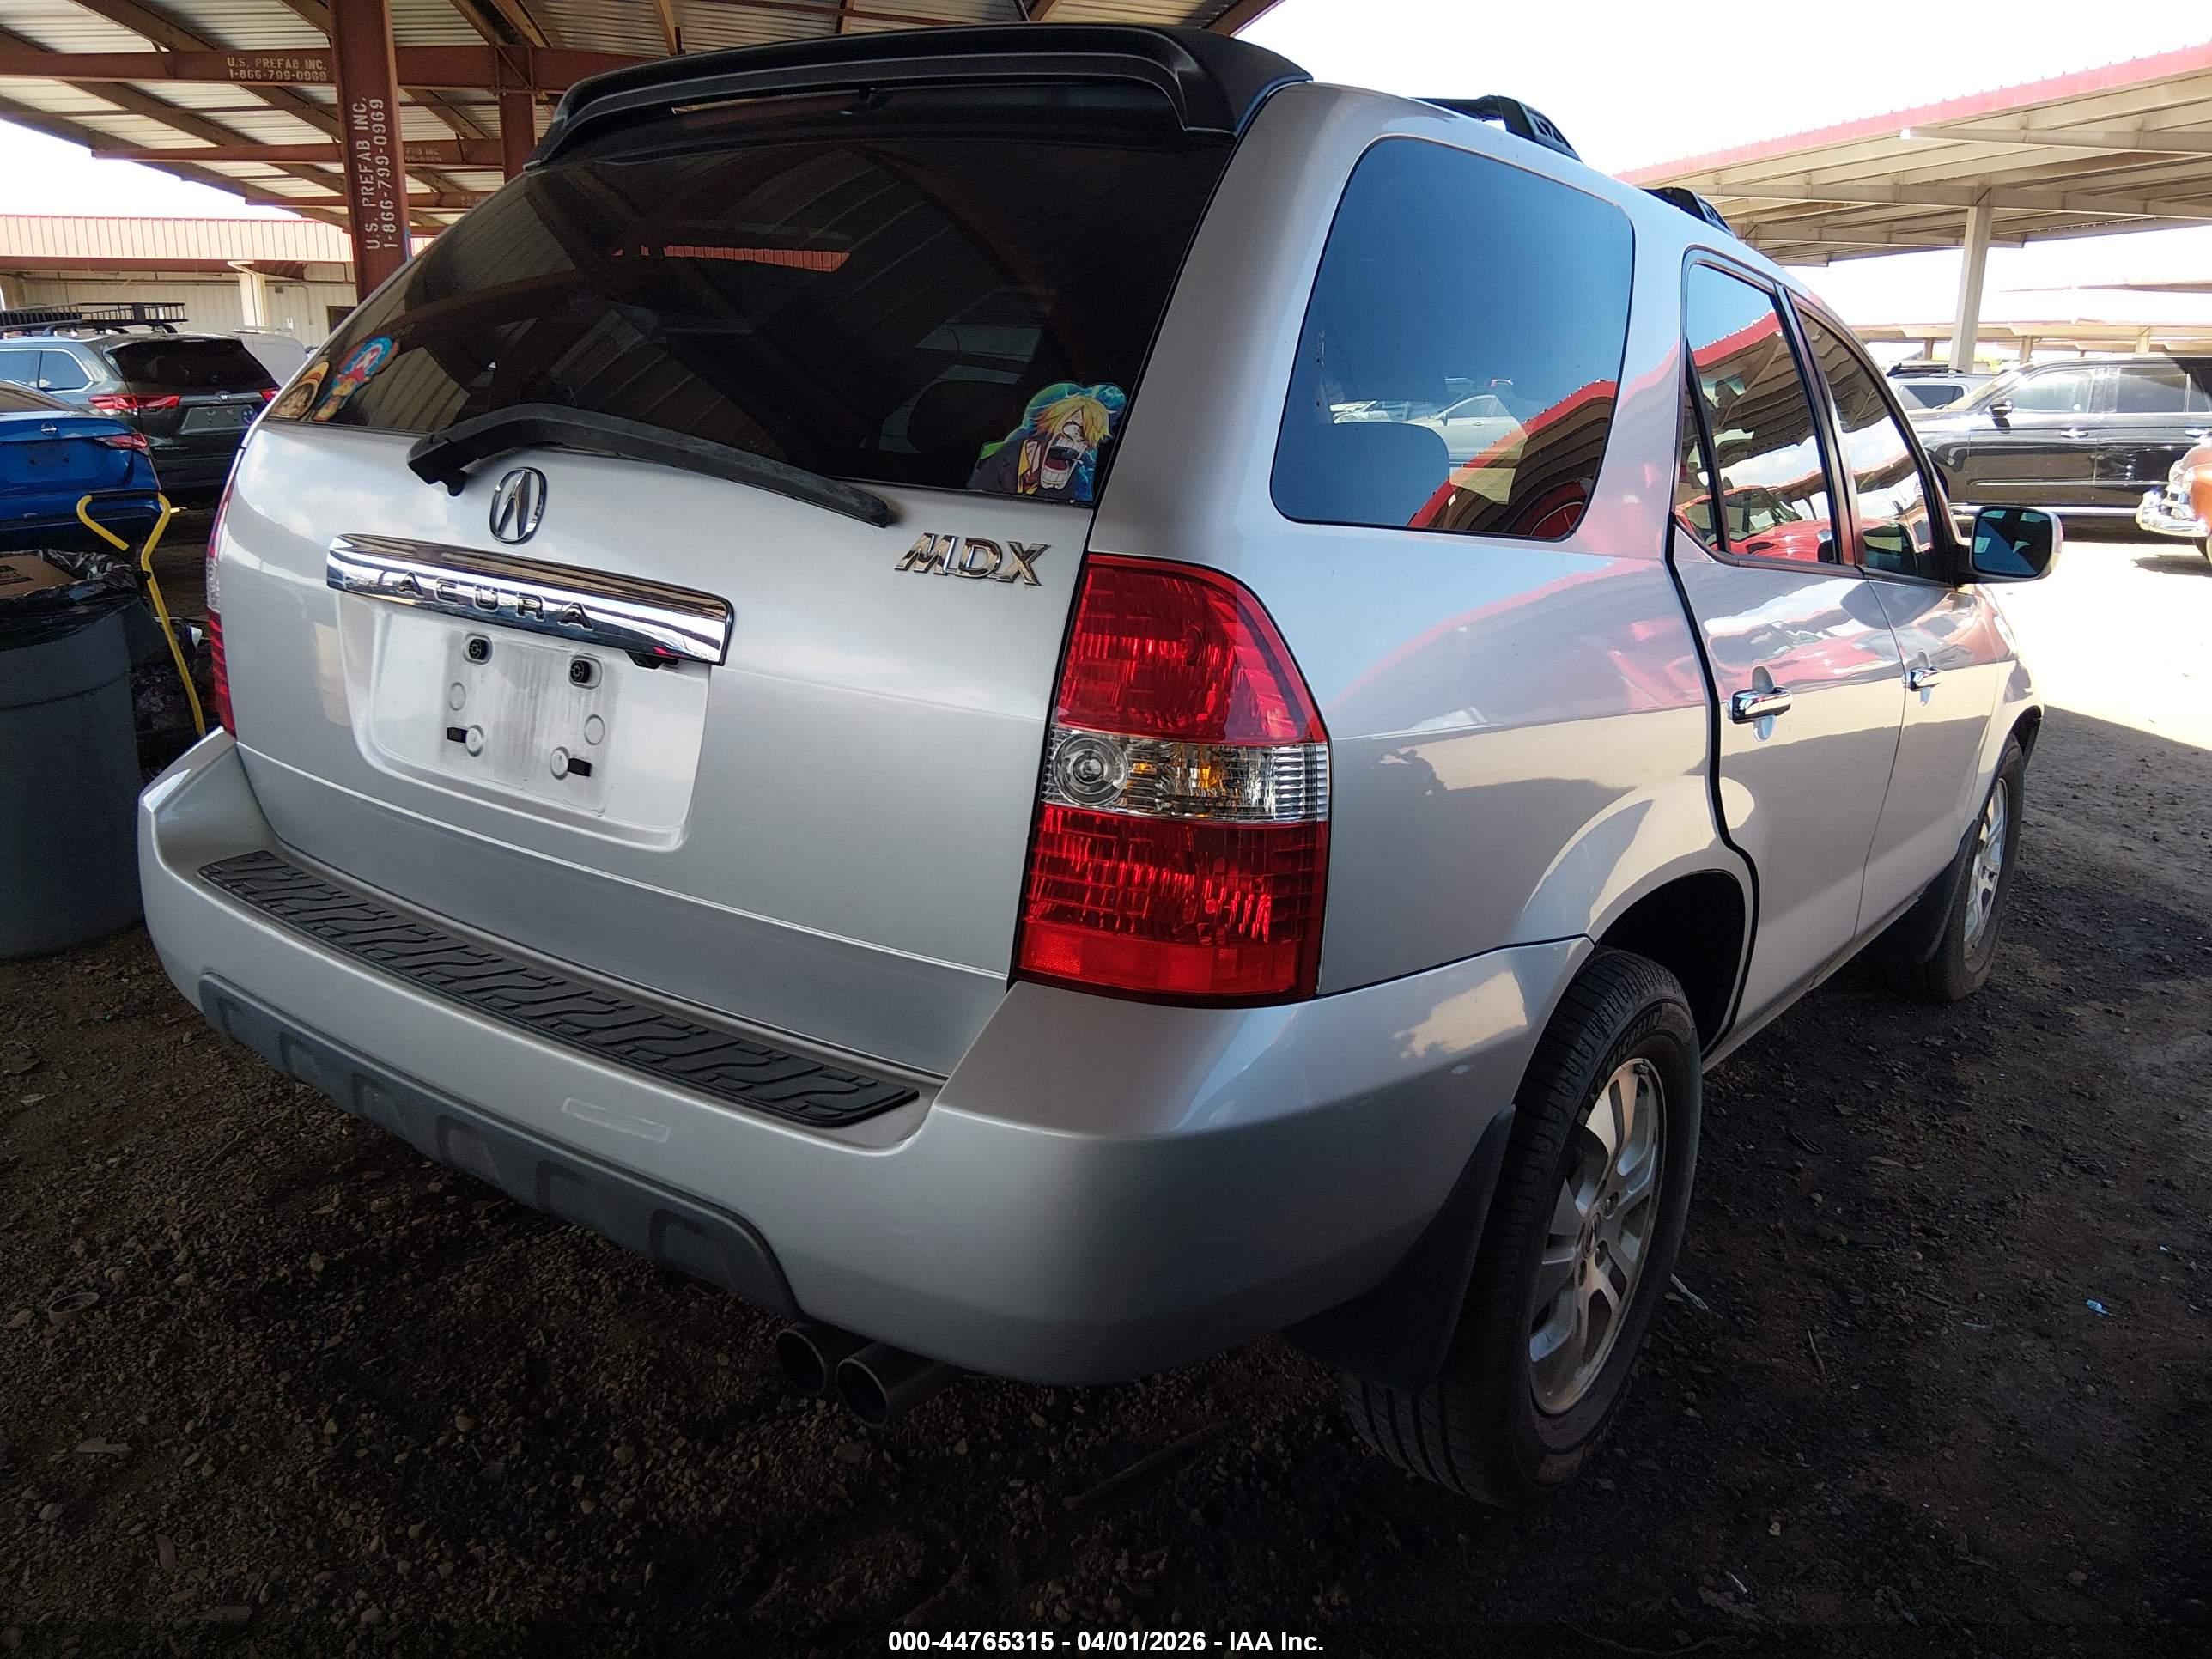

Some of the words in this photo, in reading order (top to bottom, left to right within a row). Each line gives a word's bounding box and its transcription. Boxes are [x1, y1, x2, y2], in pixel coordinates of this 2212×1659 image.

[227, 57, 249, 68] U.S.
[255, 58, 299, 69] PREFAB
[305, 59, 327, 70] INC.
[228, 69, 327, 81] 1-866-799-0969
[352, 98, 369, 130] INC.
[356, 139, 377, 207] PREFAB
[369, 99, 398, 248] 1-866-799-0969
[364, 217, 381, 250] U.S.
[893, 532, 1052, 586] MDX
[397, 570, 596, 630] ACURA
